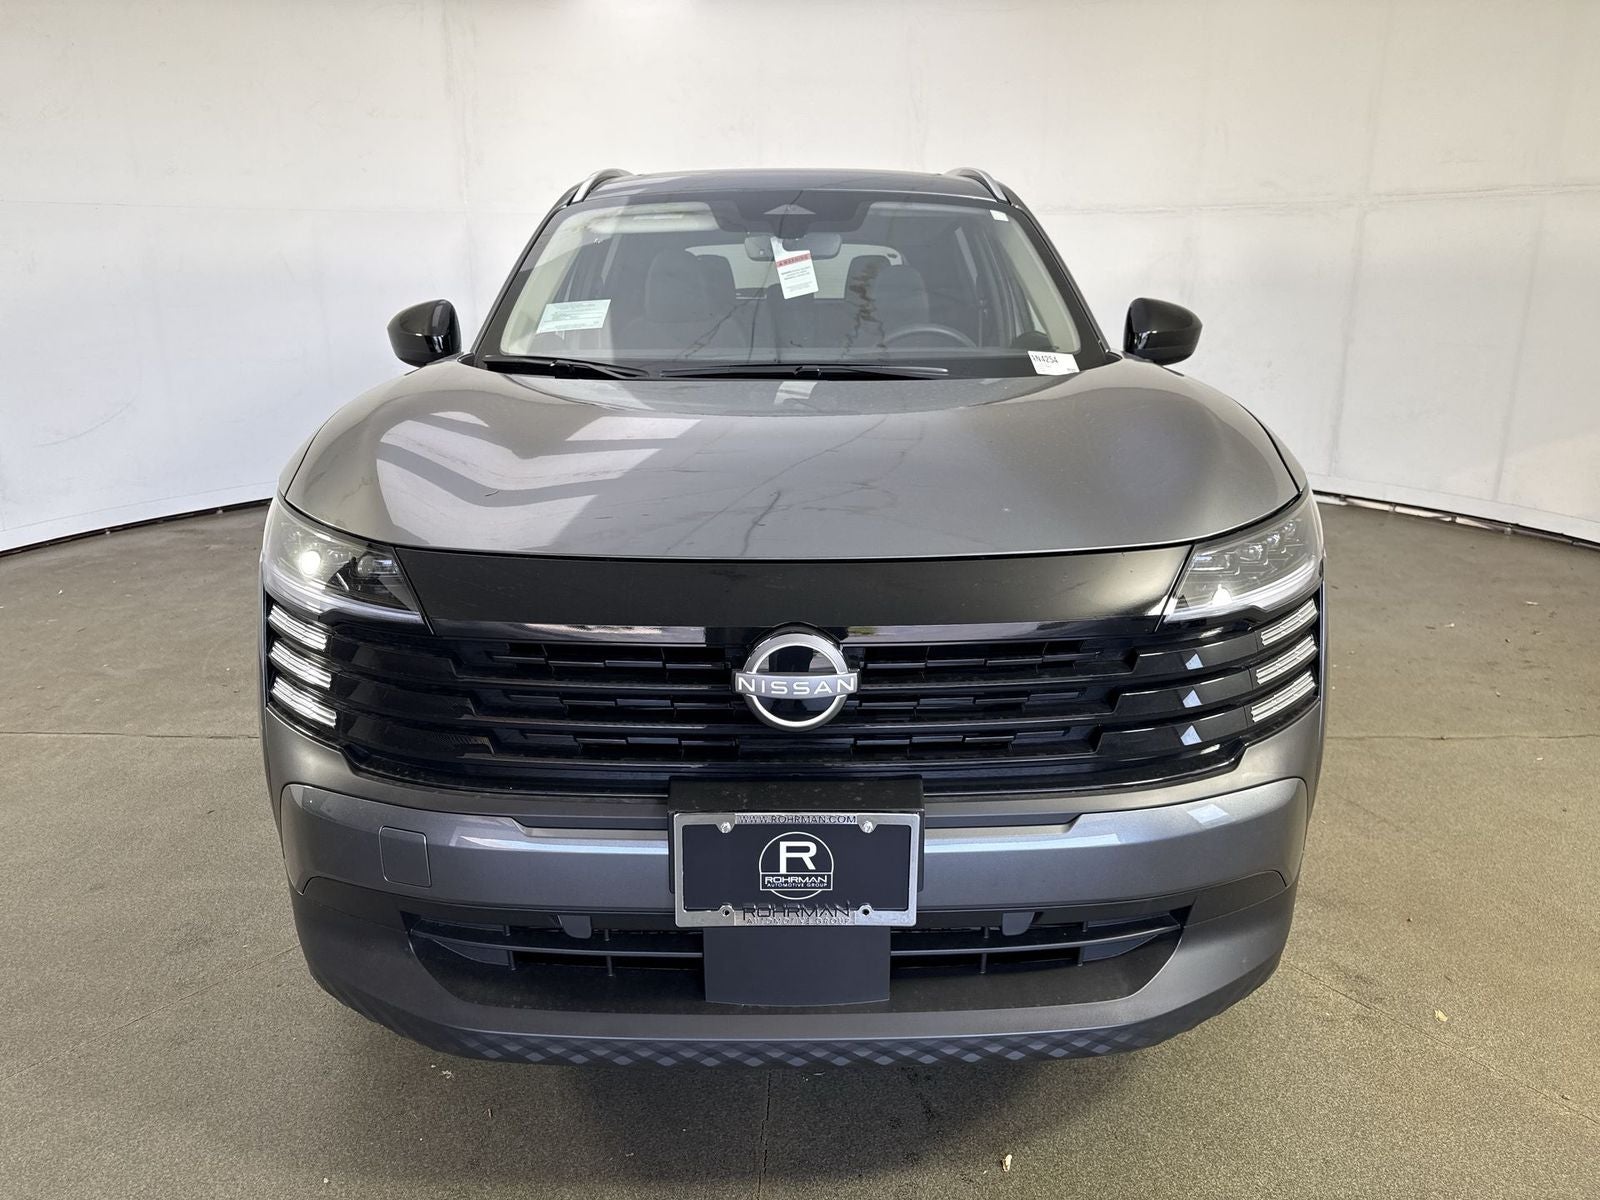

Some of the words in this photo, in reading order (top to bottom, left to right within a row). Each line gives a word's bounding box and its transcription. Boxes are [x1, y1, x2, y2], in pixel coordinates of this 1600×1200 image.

[738, 677, 854, 695] NISSAN
[740, 814, 857, 824] WWW.ROHRMAN.COM
[779, 841, 817, 873] R
[764, 875, 828, 885] ROHRMAN
[742, 901, 850, 920] ROHRMAN
